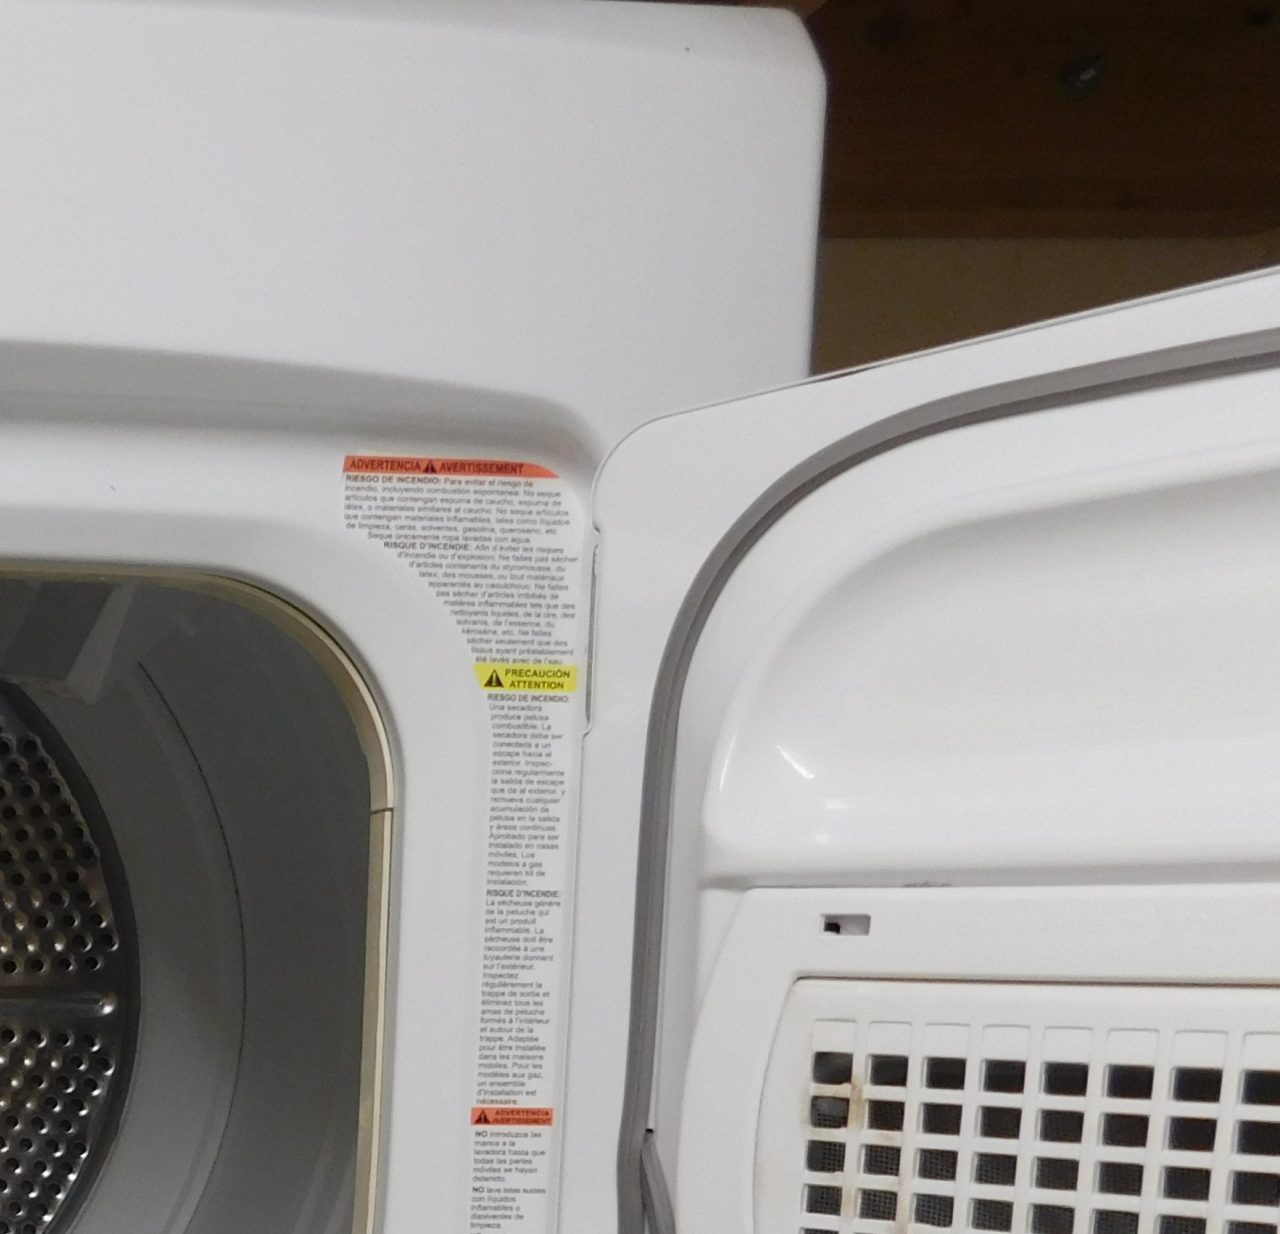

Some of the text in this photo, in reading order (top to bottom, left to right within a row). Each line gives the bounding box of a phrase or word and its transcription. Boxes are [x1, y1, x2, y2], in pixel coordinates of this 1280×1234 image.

[350, 459, 523, 476] ADVERTENCIA AVERTISSEMENT
[346, 474, 379, 483] RIESGO
[505, 669, 570, 678] PRECAUCIÓN
[509, 680, 564, 689] ATTENTION
